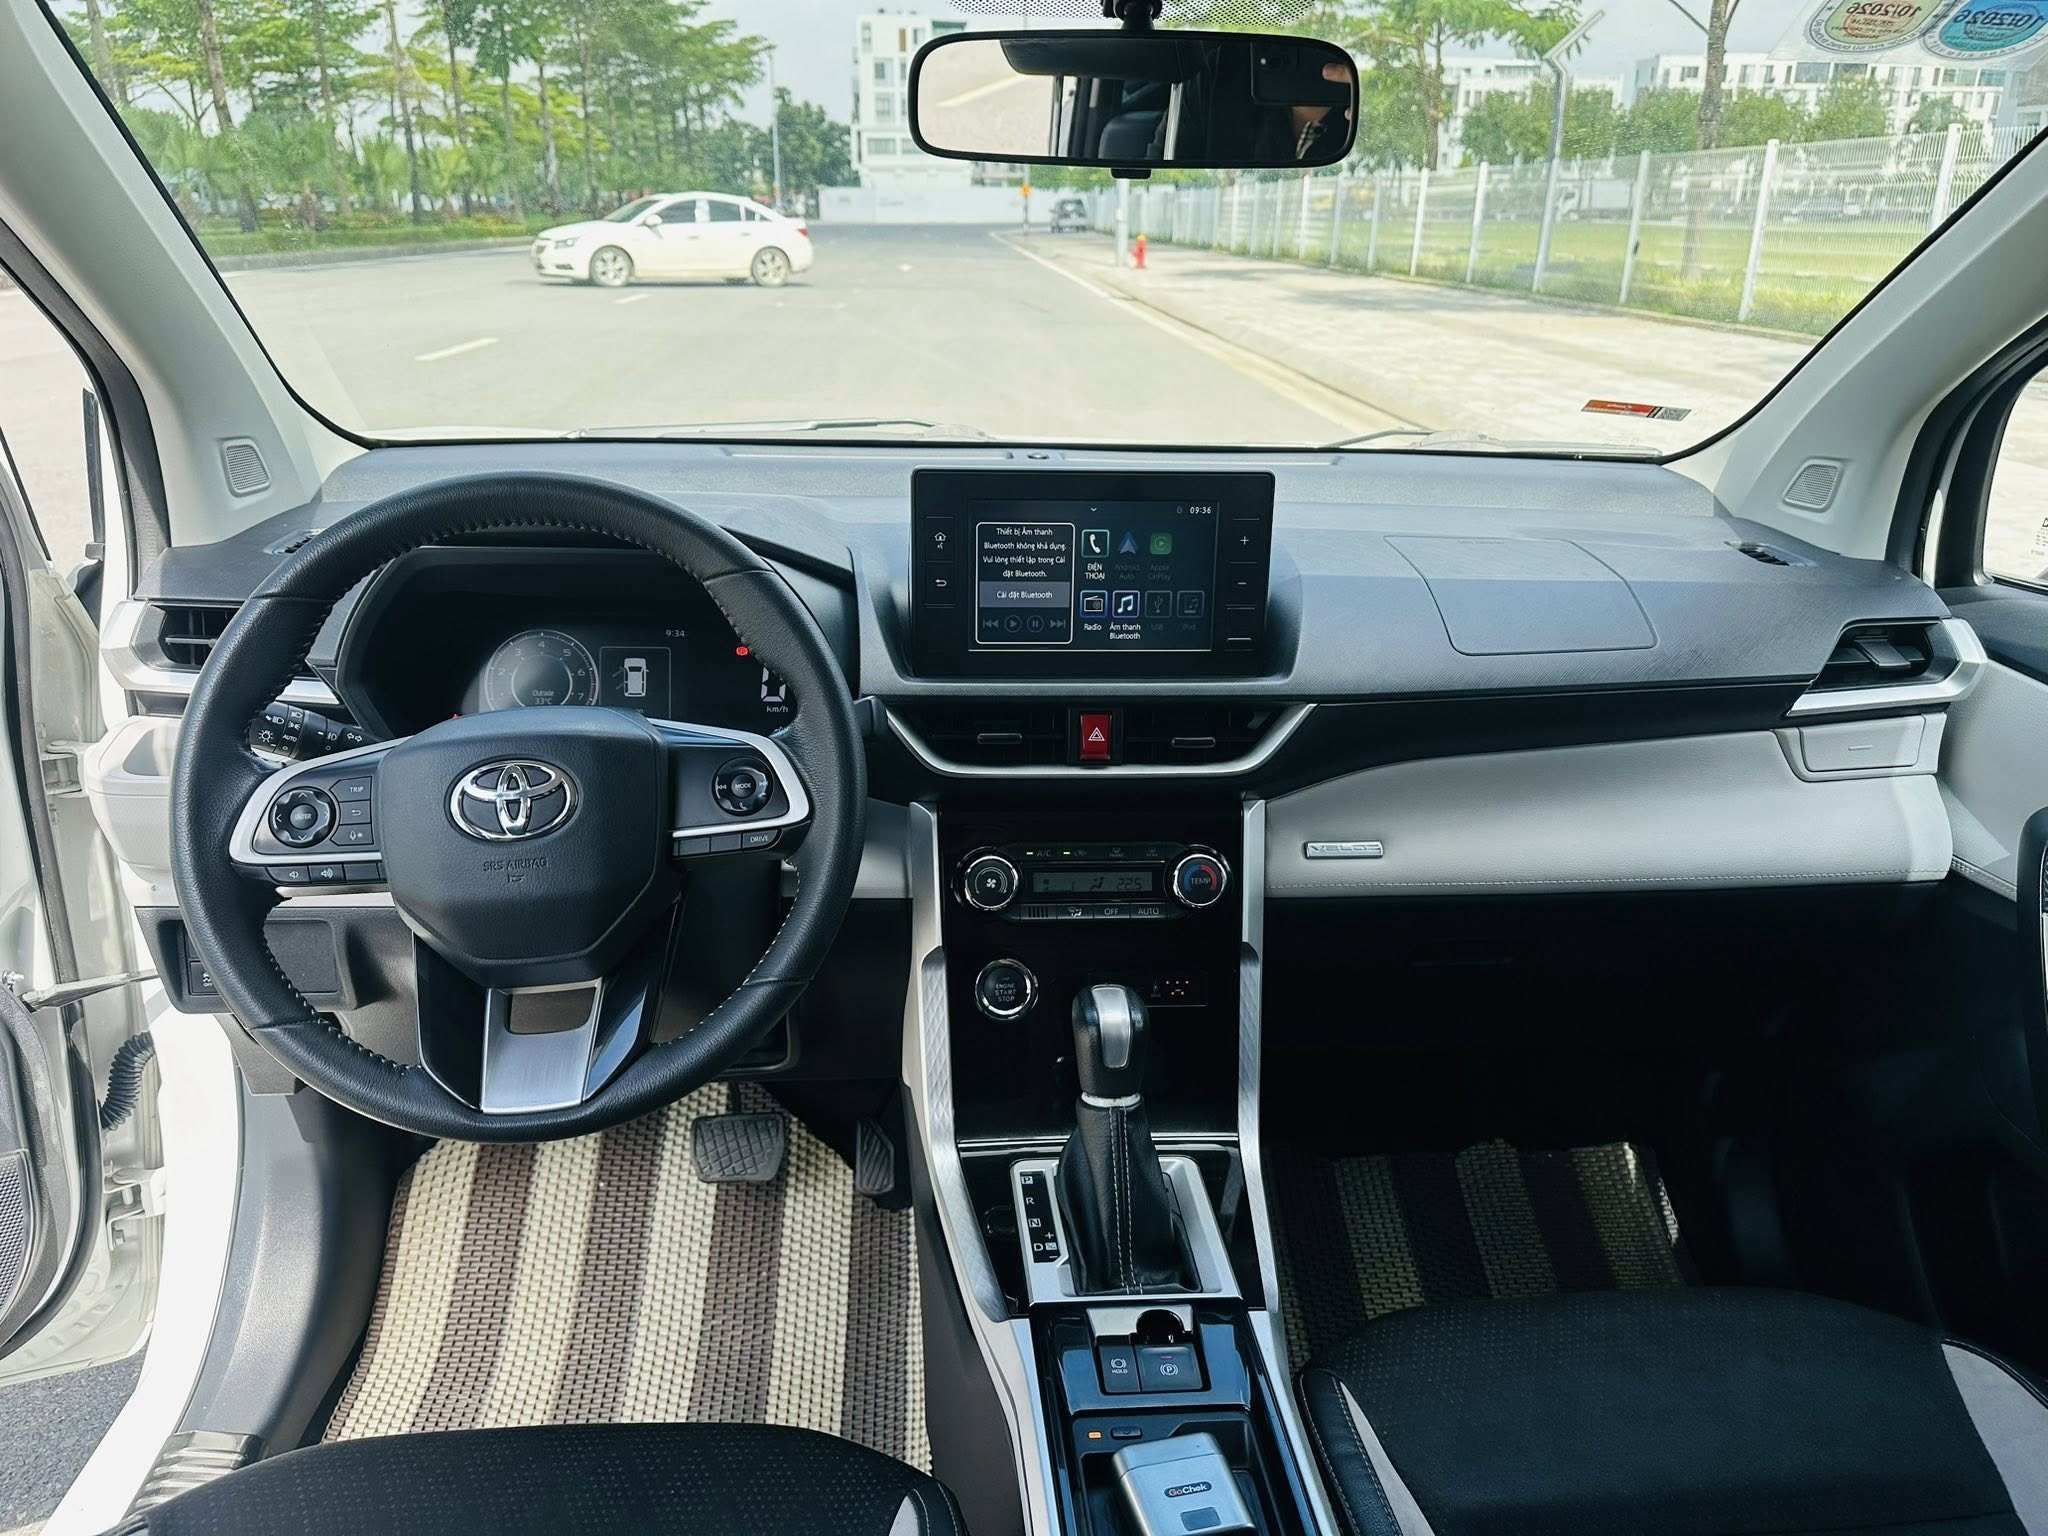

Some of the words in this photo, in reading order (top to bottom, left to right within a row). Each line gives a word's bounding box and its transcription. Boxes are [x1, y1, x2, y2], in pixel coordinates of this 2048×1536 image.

[1190, 506, 1212, 514] 09:36
[1034, 528, 1053, 536] thanh
[984, 542, 1015, 550] Bluetooth
[1016, 542, 1035, 552] không
[1037, 556, 1054, 565] trong
[1020, 590, 1053, 599] Bluetooth
[1083, 623, 1102, 631] Radio
[1122, 623, 1141, 631] thanh
[665, 630, 685, 638] 9:34
[1109, 632, 1141, 640] Bluetooth
[563, 649, 571, 657] 5
[577, 668, 586, 676] 6
[532, 689, 555, 697] Outside
[577, 693, 585, 701] 7
[766, 705, 789, 713] km/h
[282, 733, 298, 743] AUTO
[294, 813, 312, 821] ENTER
[750, 835, 769, 843] DRIVE
[1036, 849, 1052, 857] A/C
[483, 860, 504, 872] SRS
[506, 856, 548, 871] AIRBAG
[1191, 877, 1212, 885] TEMP
[1137, 907, 1160, 915] AUTO
[1026, 1197, 1035, 1205] R
[1033, 1243, 1044, 1252] D
